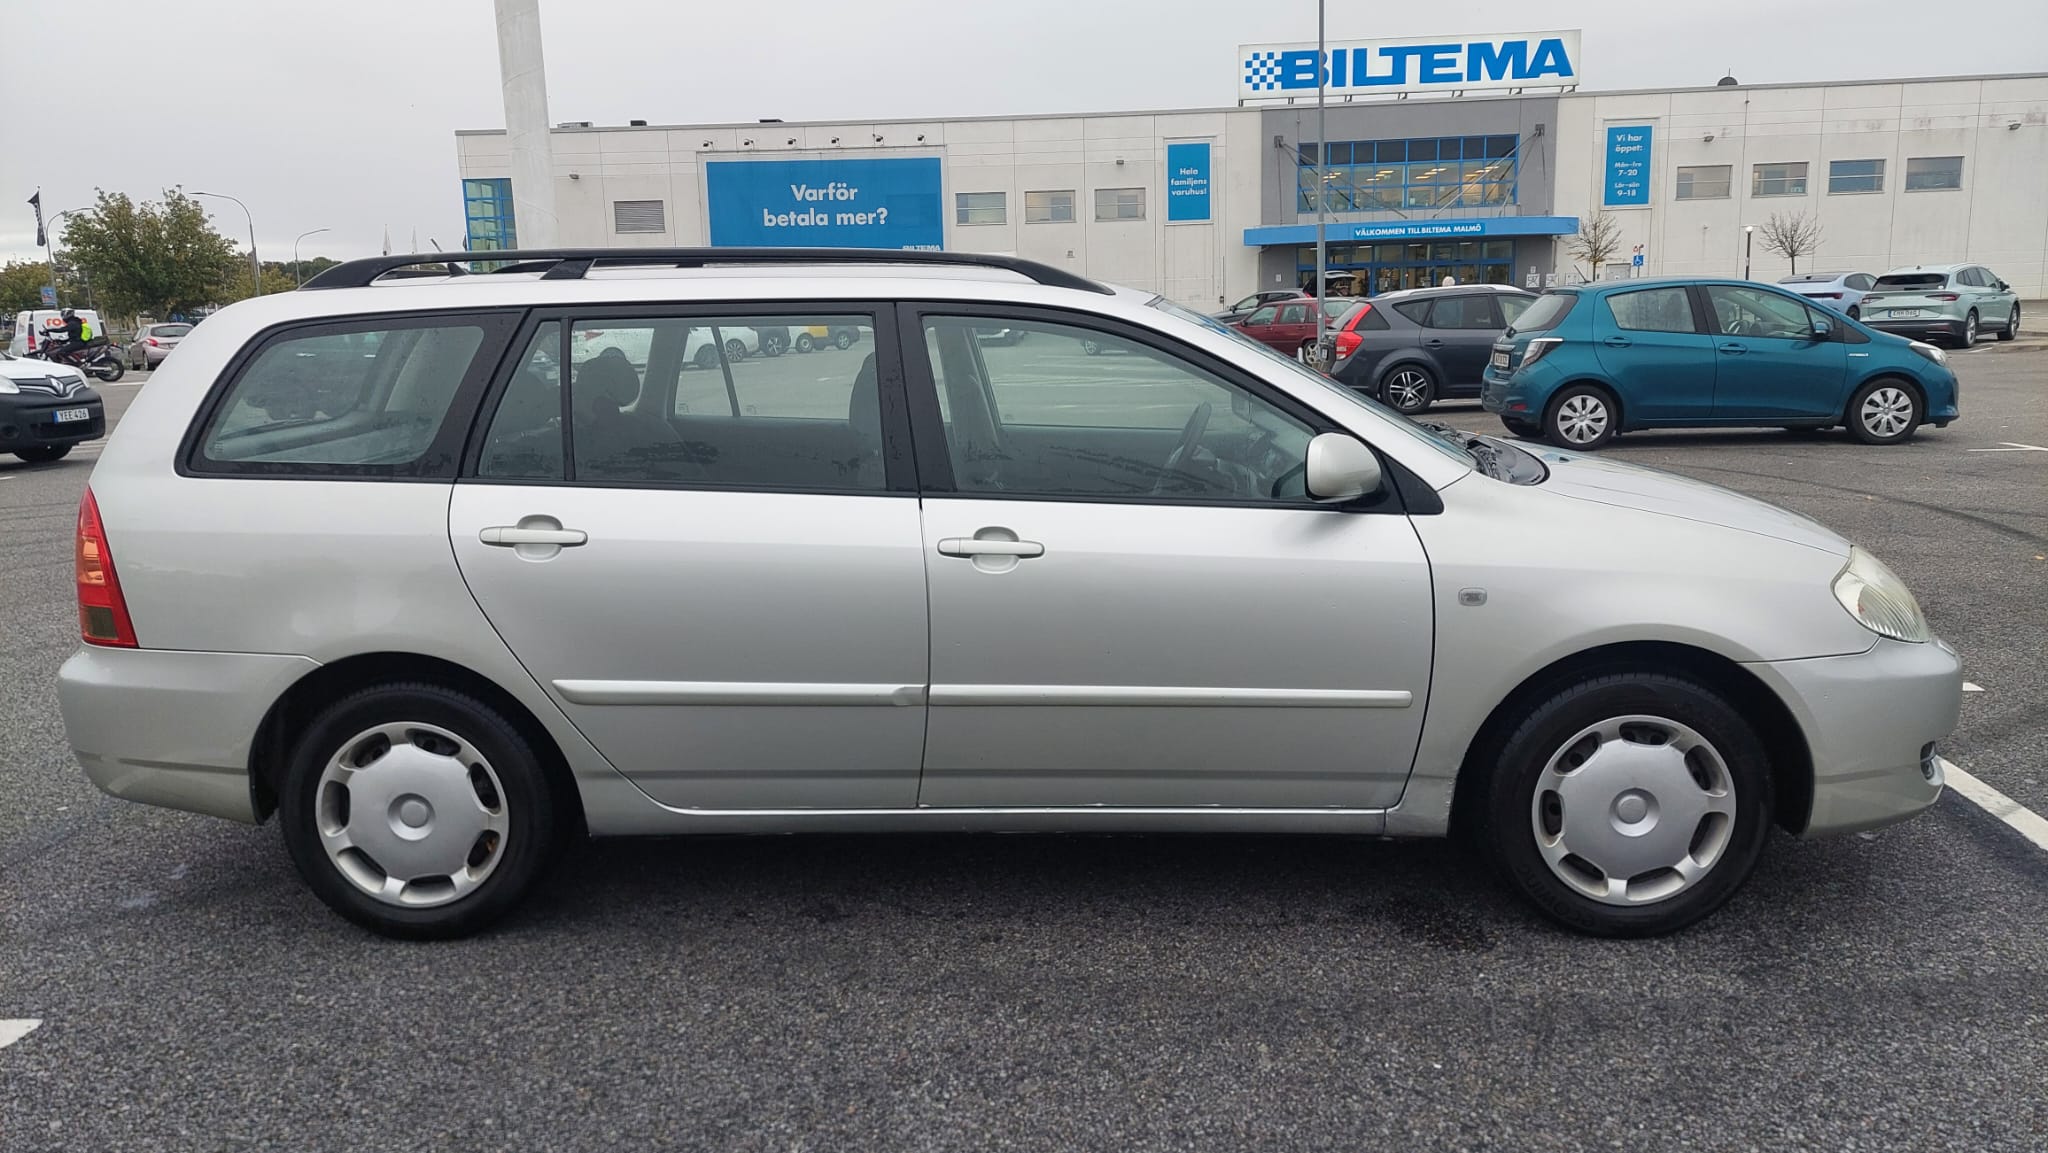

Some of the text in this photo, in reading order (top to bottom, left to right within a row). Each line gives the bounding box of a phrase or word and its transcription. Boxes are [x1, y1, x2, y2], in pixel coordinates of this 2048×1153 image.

[1281, 38, 1575, 90] BILTEMA
[1616, 133, 1643, 142] Vi har
[1615, 144, 1643, 154] öppet:
[1179, 167, 1199, 175] Hela
[1170, 177, 1207, 187] familjens
[790, 182, 858, 202] Varför
[1171, 187, 1207, 196] varuhus!
[763, 207, 888, 227] betala mer?
[1355, 224, 1482, 237] VÄLKOMMEN TILL BILTEMA MALMÖ
[59, 410, 73, 420] YEE
